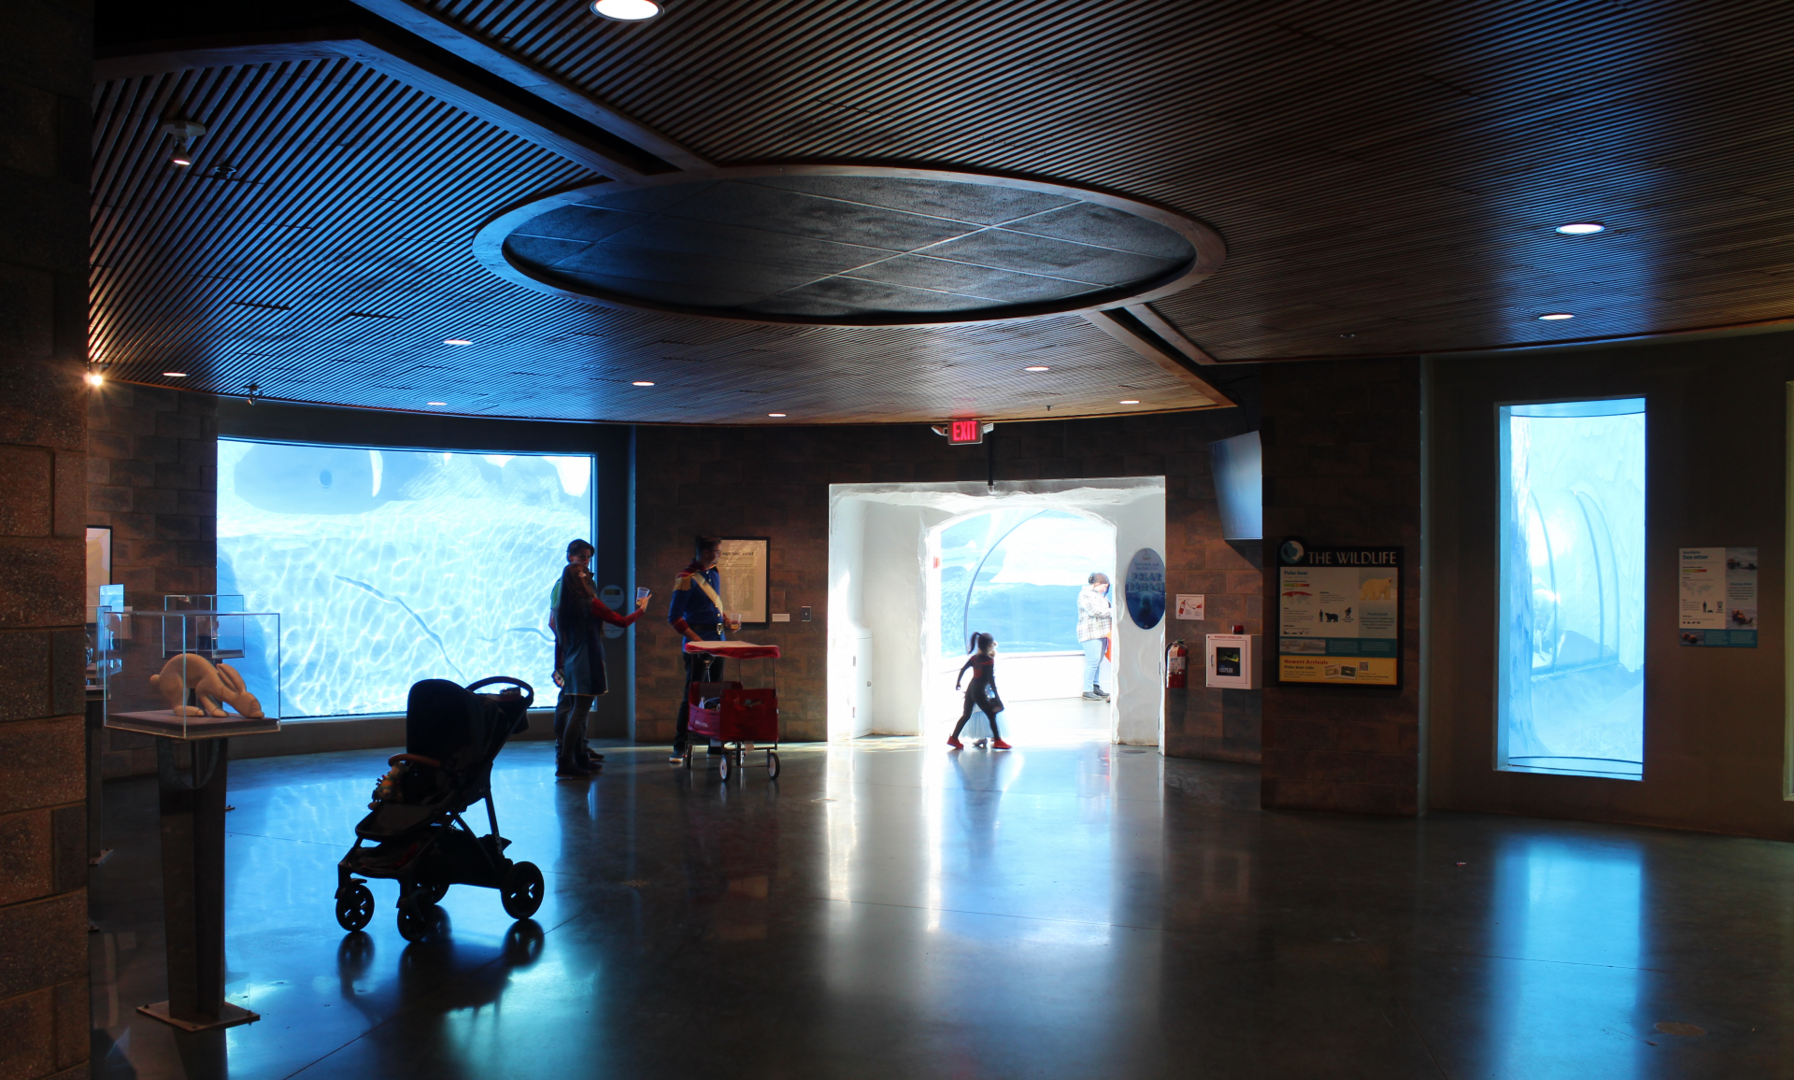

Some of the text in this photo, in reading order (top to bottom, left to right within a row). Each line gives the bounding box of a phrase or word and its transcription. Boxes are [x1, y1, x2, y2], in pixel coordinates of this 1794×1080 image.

[952, 421, 977, 441] EXIT
[1307, 551, 1397, 565] THE WILDLIFE
[1132, 572, 1162, 581] POLAR
